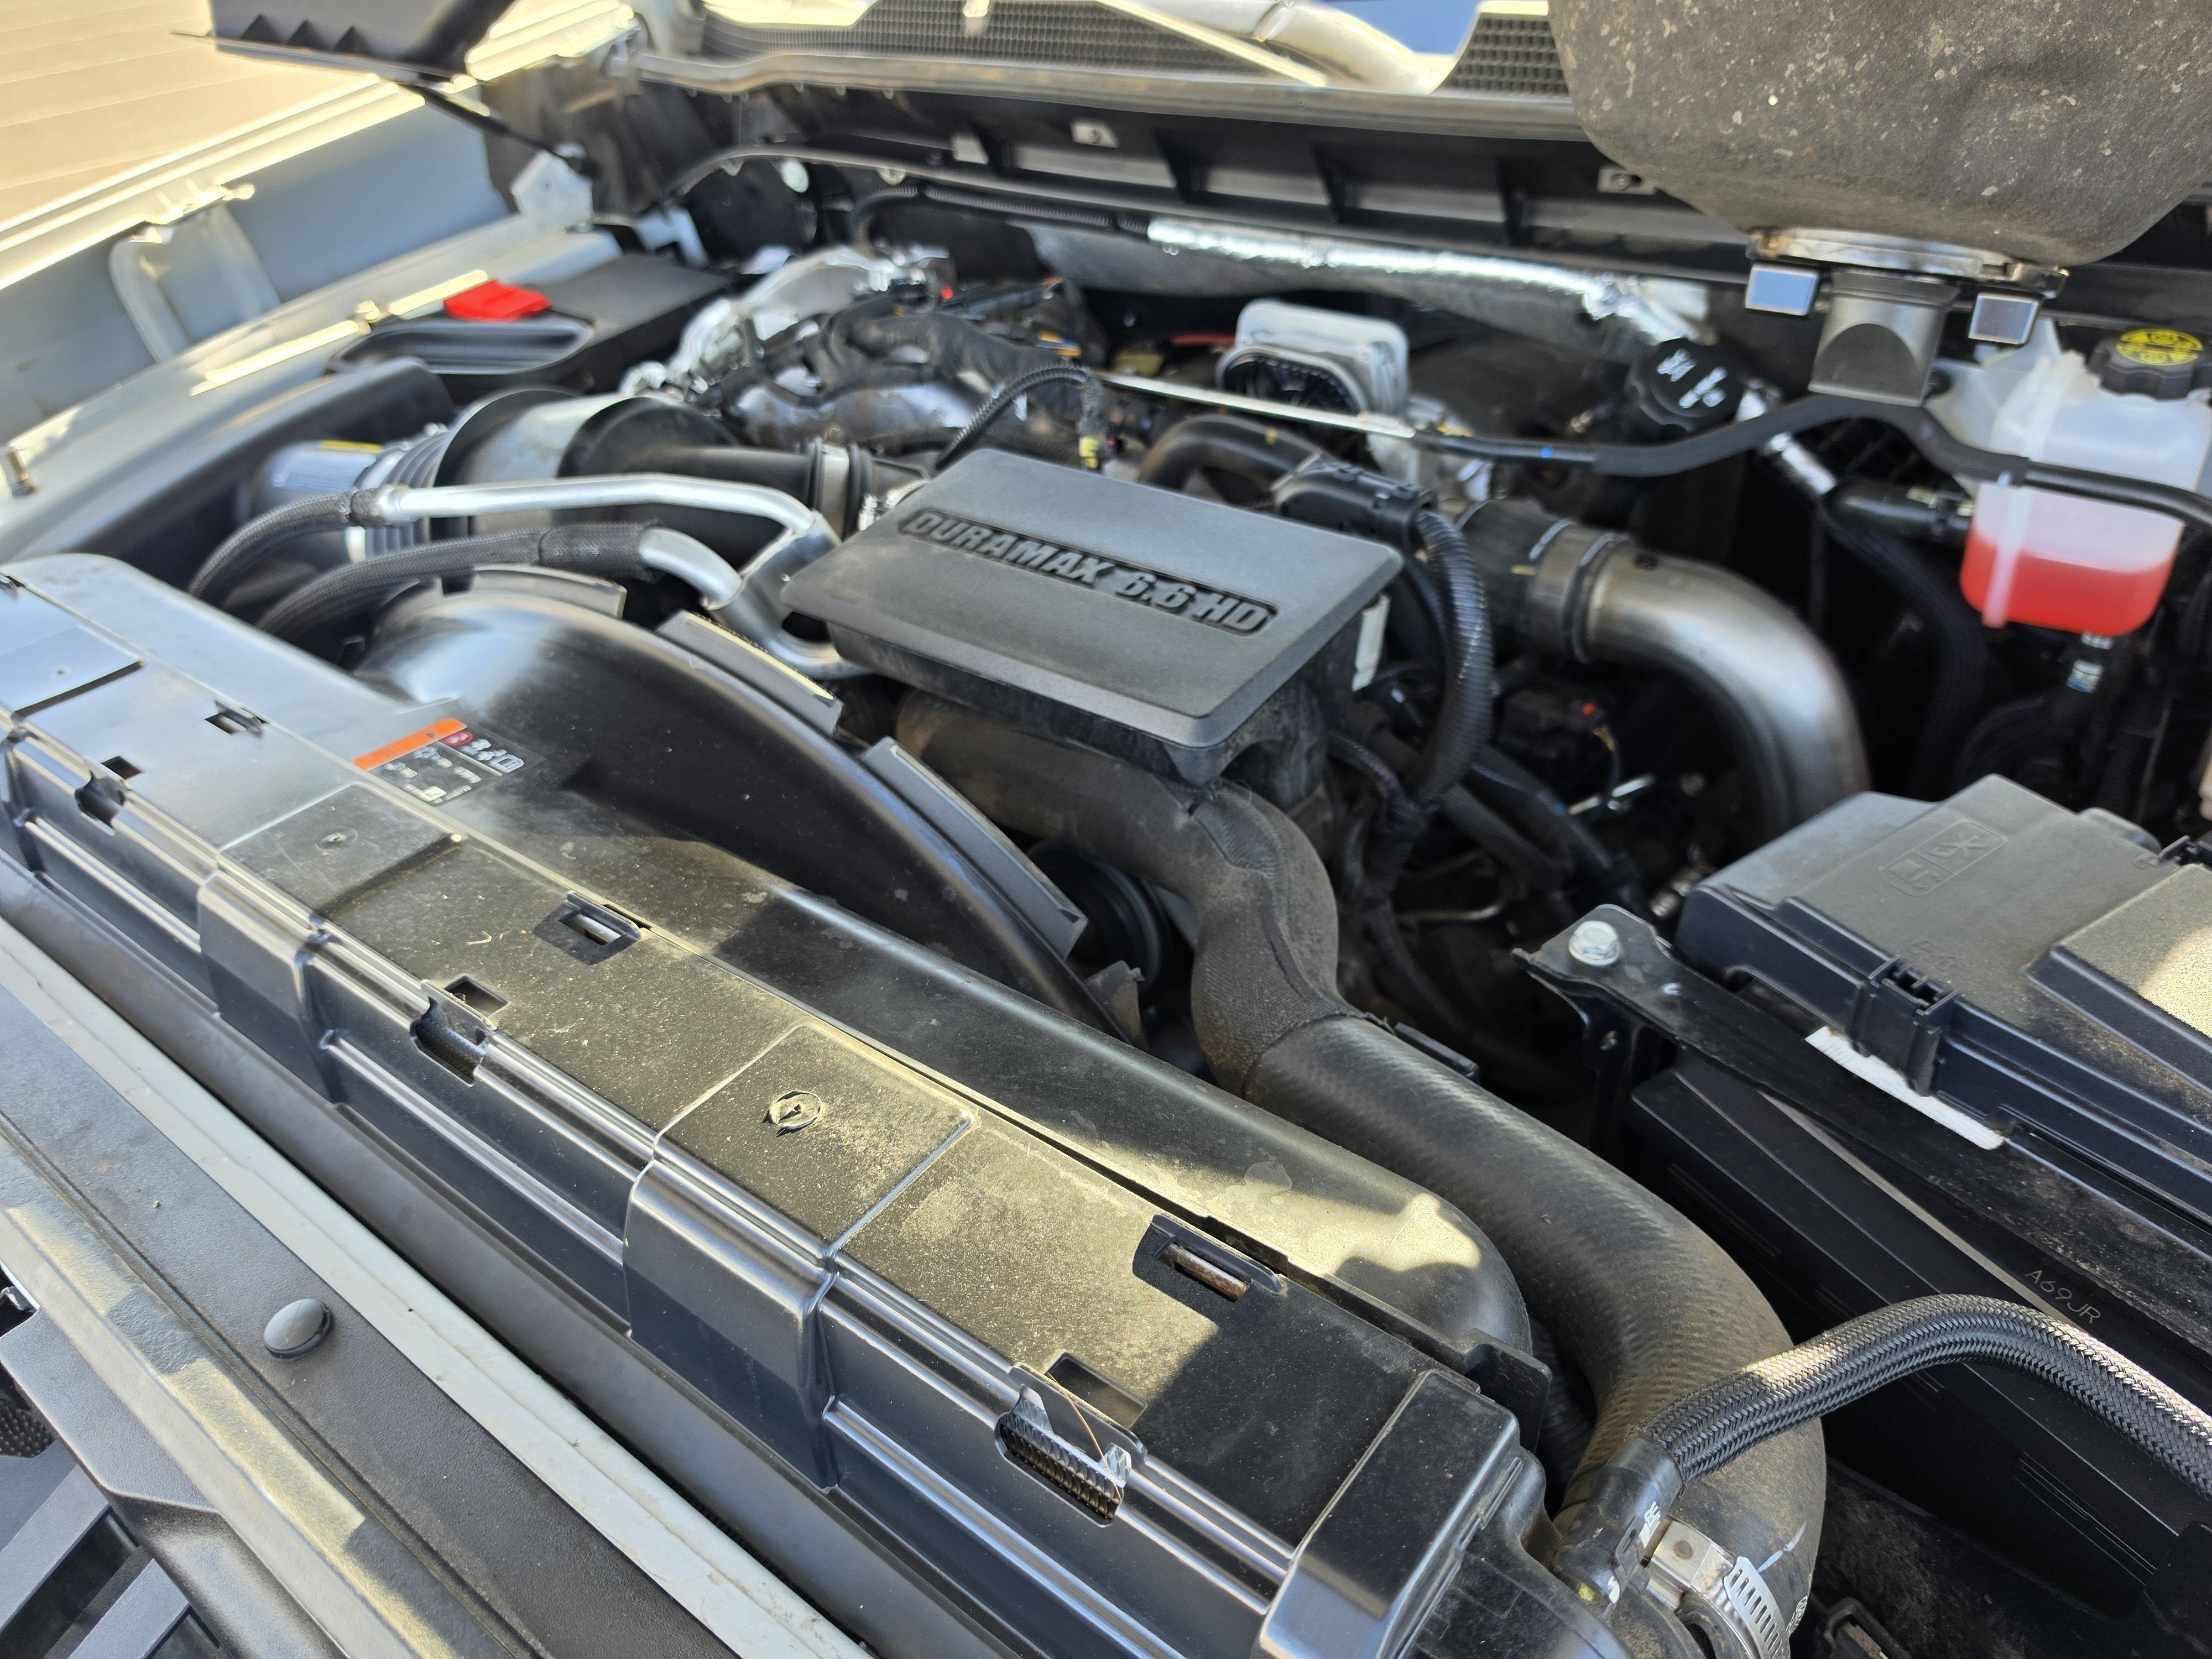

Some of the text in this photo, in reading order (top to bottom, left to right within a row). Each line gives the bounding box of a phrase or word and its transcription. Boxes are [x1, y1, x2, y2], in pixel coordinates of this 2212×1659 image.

[902, 510, 1270, 632] DURAMAX 6.6 HD
[2025, 1270, 2101, 1323] A69JR
